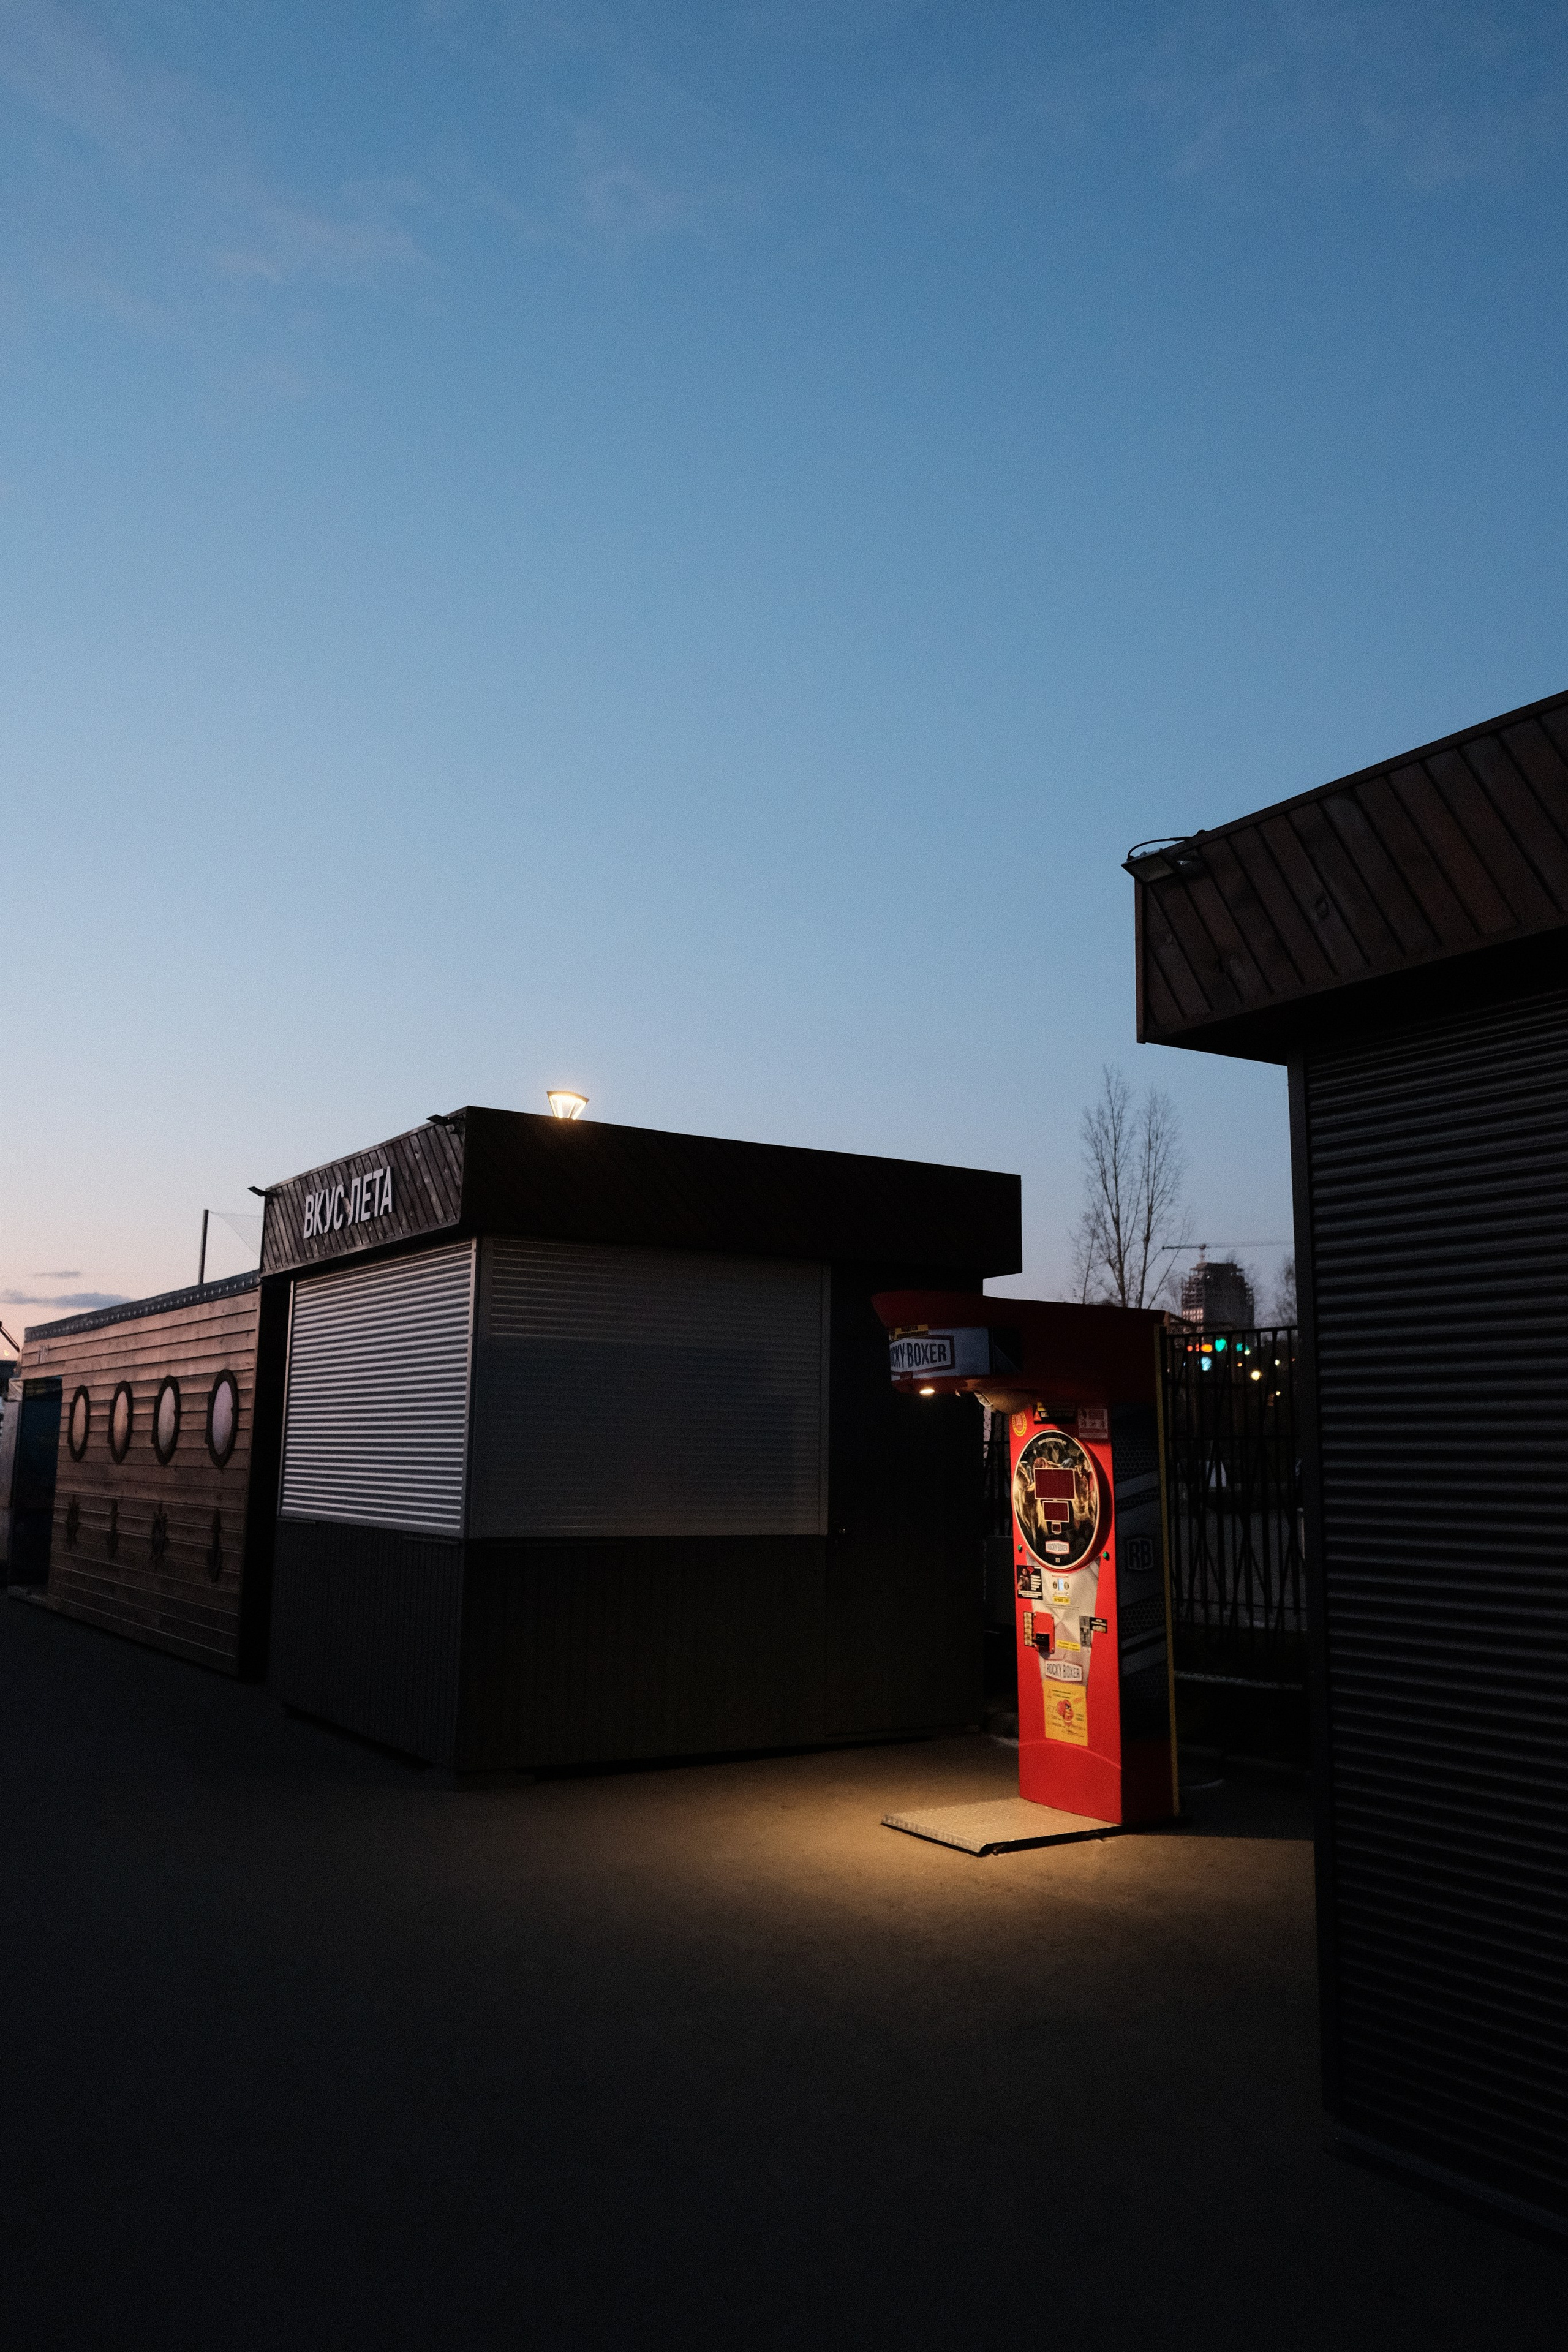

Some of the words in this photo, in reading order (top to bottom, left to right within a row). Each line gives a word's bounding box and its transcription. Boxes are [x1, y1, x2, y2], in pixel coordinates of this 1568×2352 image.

[303, 1184, 345, 1239] ВКУС
[348, 1166, 394, 1225] ЛЕТА
[907, 1343, 947, 1368] BOXER
[1046, 1663, 1062, 1676] ROCKY
[1063, 1664, 1081, 1679] BOXER
